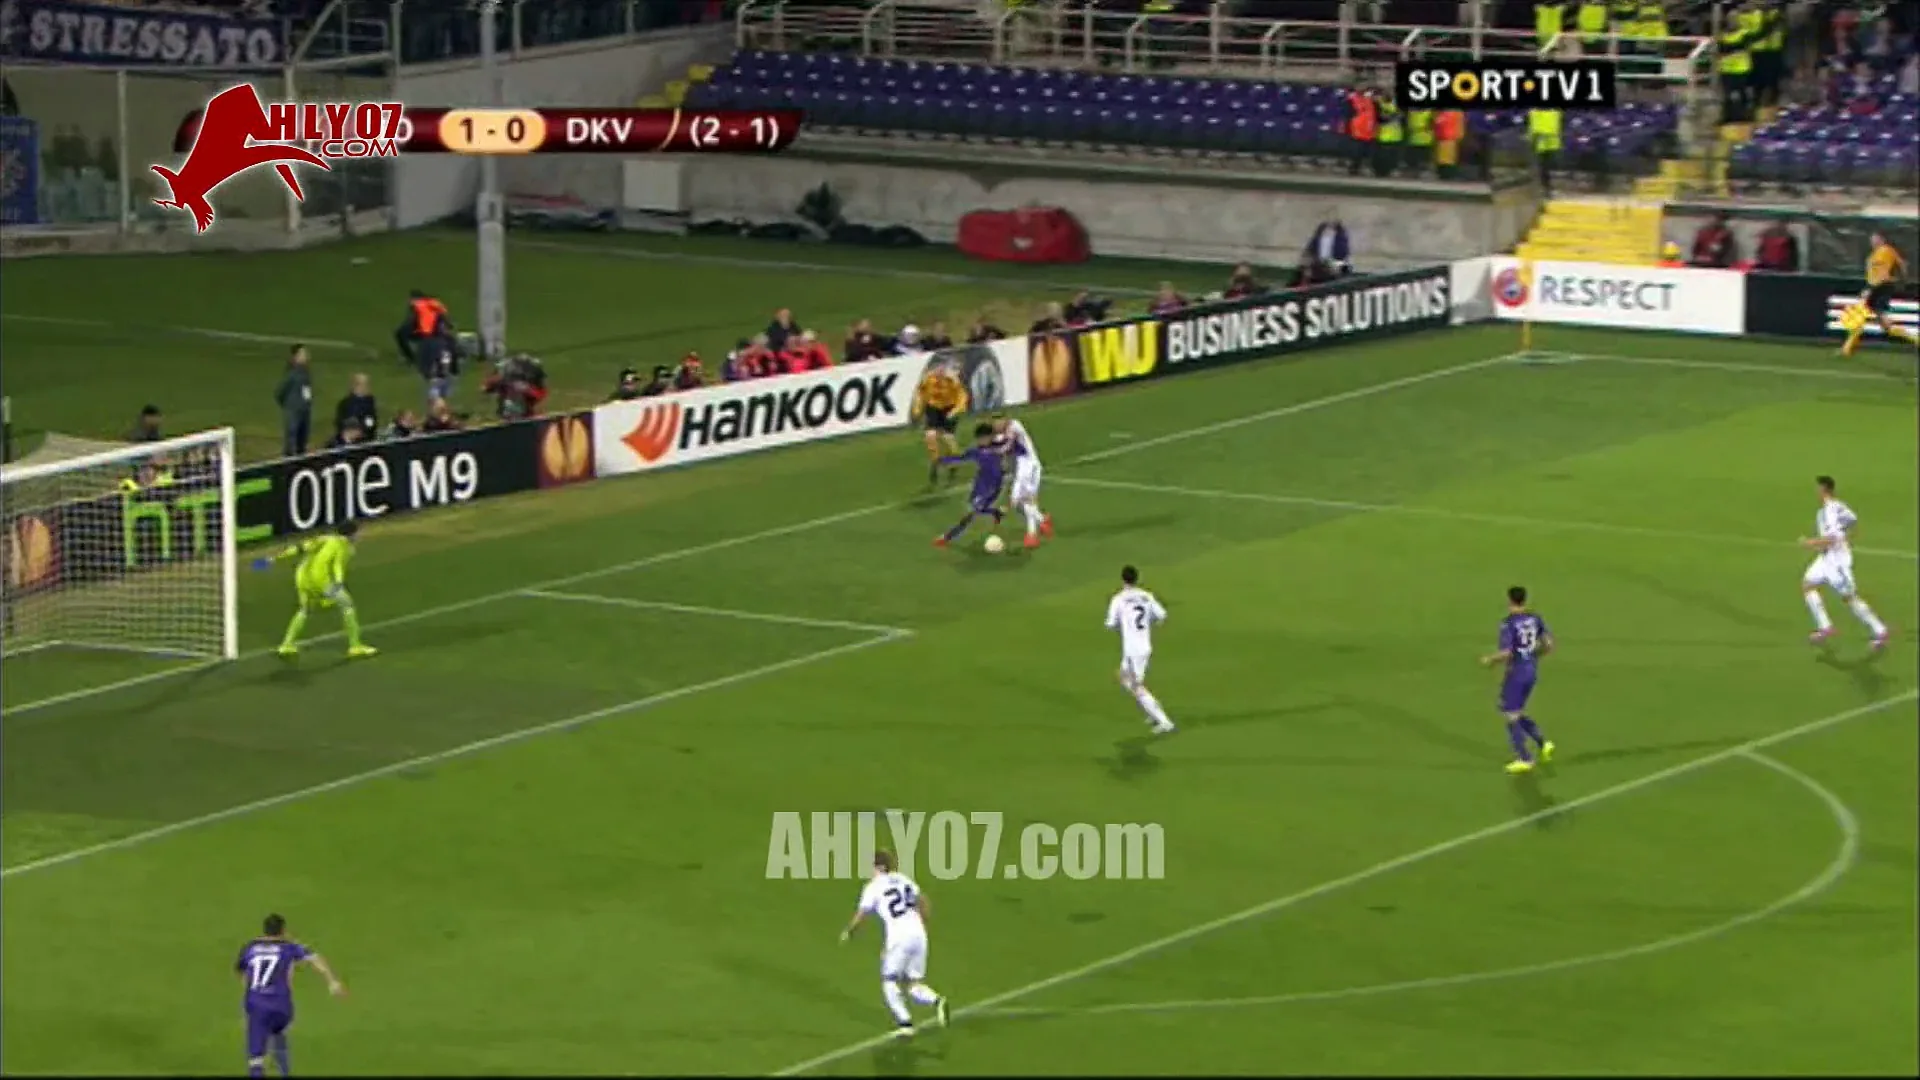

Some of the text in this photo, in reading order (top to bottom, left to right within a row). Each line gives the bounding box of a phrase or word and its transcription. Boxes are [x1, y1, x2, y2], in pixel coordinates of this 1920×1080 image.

[29, 9, 277, 66] STRESSATO
[1540, 275, 1675, 311] RESPECT
[1167, 301, 1299, 363] BUSINESS
[1304, 276, 1448, 338] SOLUTIONS
[289, 454, 392, 530] one
[409, 452, 478, 509] M9
[1133, 605, 1145, 631] 2
[883, 885, 918, 919] 24
[250, 954, 279, 990] 17
